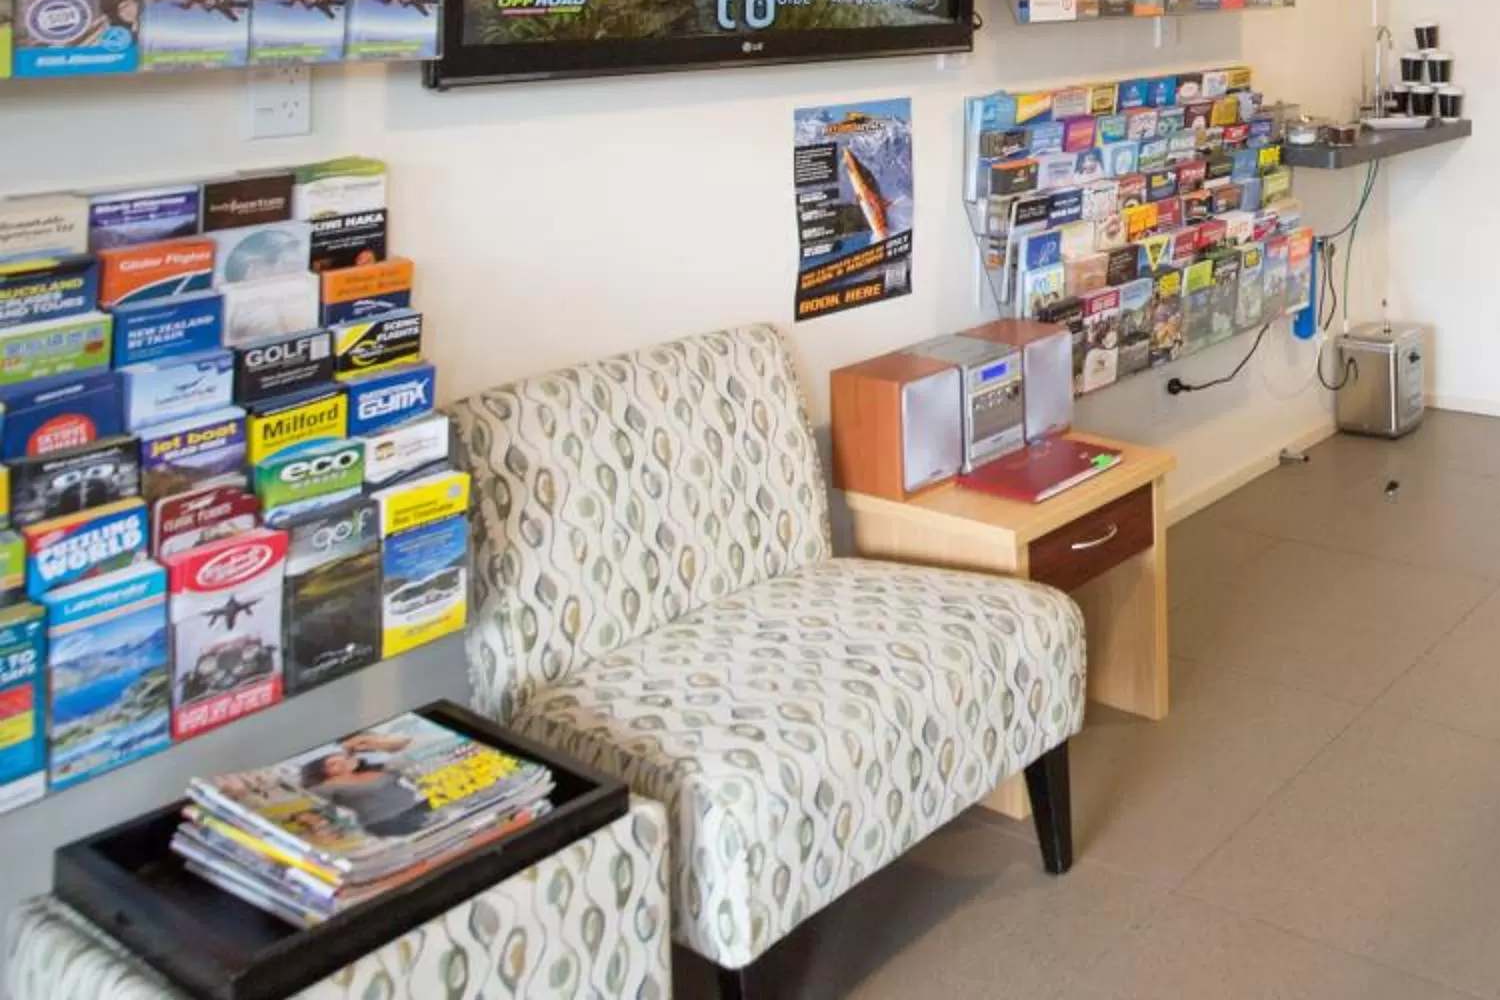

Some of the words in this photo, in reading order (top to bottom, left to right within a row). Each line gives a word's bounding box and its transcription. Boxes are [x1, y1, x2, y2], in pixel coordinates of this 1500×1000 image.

[345, 212, 385, 228] HAKA
[799, 293, 841, 313] BOOK
[844, 283, 883, 304] HERE
[128, 328, 158, 340] NEW
[158, 315, 216, 336] ZEALAND
[128, 338, 150, 349] BY
[152, 331, 186, 345] TRAIN
[245, 338, 312, 368] GOLF
[187, 422, 238, 445] boat
[262, 404, 339, 441] Milford
[279, 450, 360, 482] eco
[37, 513, 141, 562] PUZZLING
[312, 507, 374, 553] golf
[39, 528, 143, 582] WORLD
